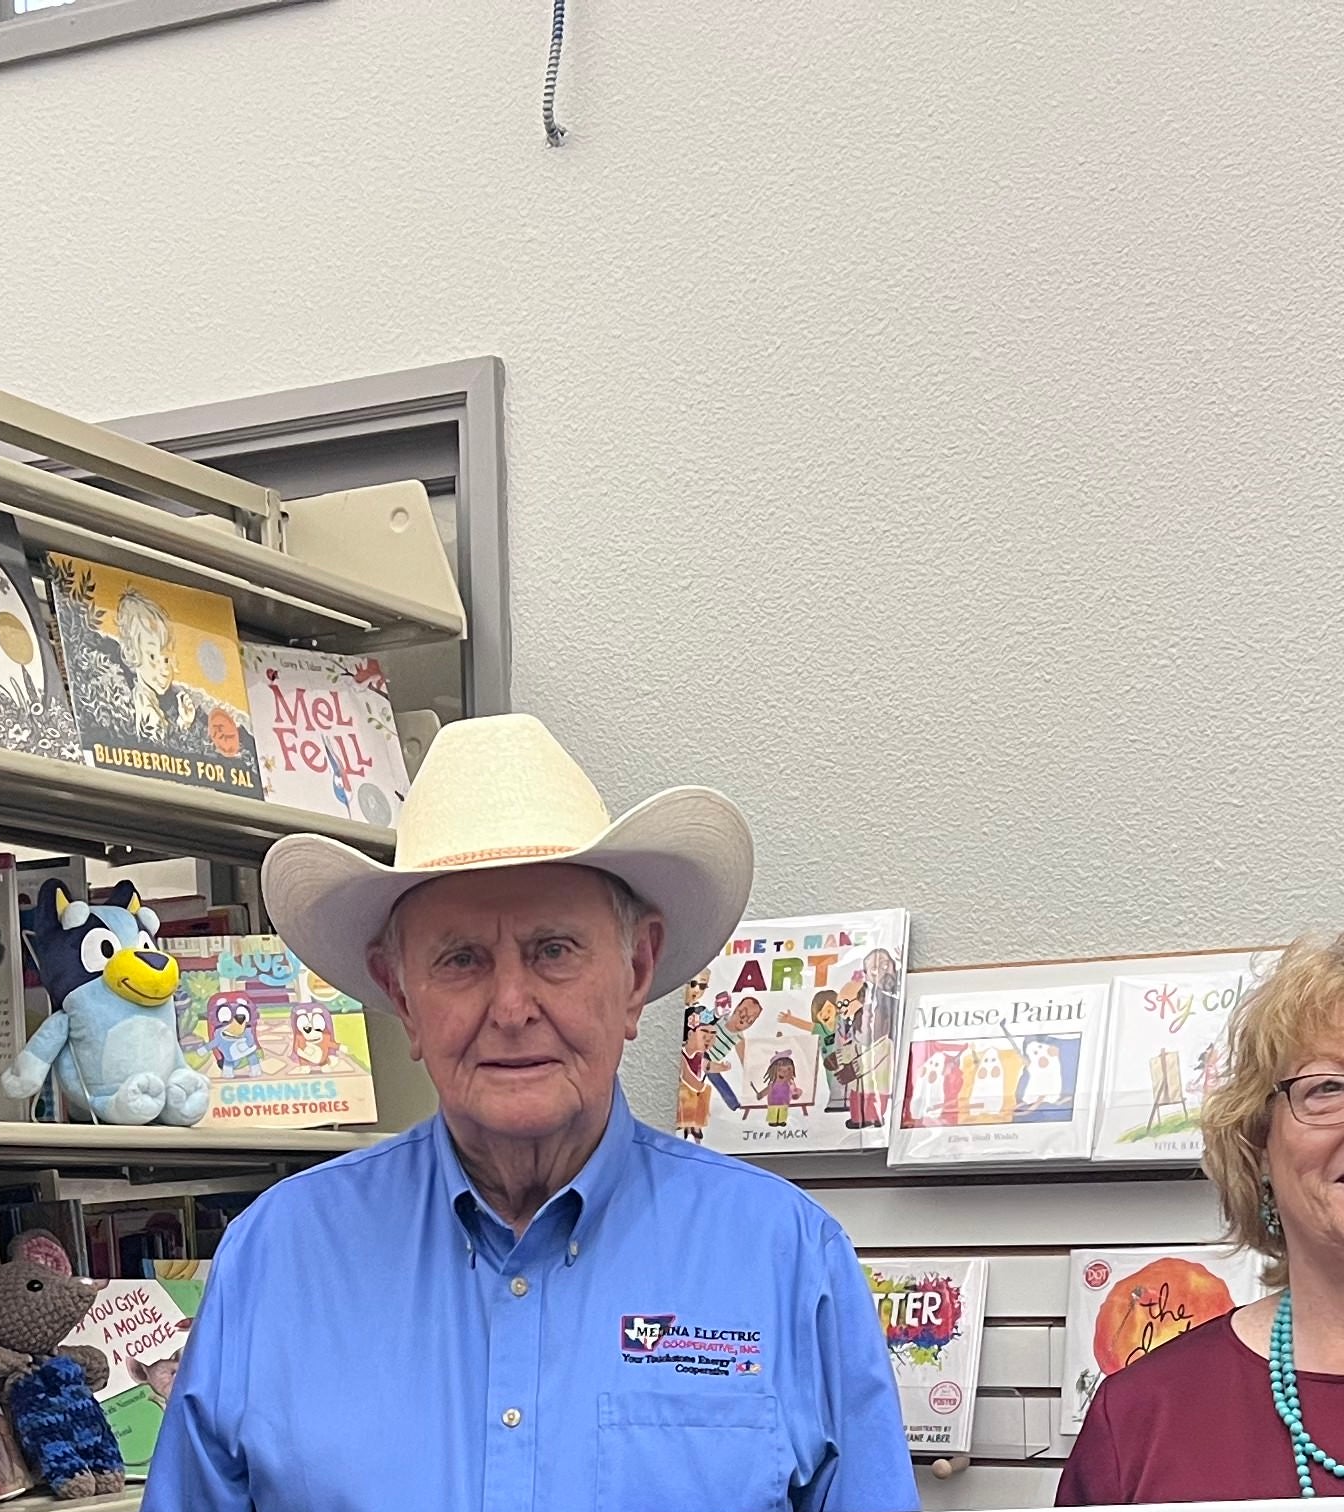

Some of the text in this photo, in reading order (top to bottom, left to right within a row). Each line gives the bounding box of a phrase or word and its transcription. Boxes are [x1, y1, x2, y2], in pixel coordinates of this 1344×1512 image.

[94, 743, 254, 789] BLUEBERRIES FOR SAL
[774, 939, 795, 952] TO
[732, 954, 838, 993] ART
[914, 999, 1087, 1030] Mouse Paint
[220, 1081, 338, 1103] GRANNIES
[213, 1101, 350, 1118] AND OTHER STORIES
[743, 1129, 808, 1141] JEFF MACK
[86, 1287, 150, 1325] YOU GIVE
[1141, 1282, 1192, 1322] the
[103, 1306, 163, 1343] A MOUSE
[636, 1326, 760, 1342] MEDINA ELECTRIC
[112, 1321, 176, 1365] A COOKIE
[675, 1364, 729, 1376] Cooperative
